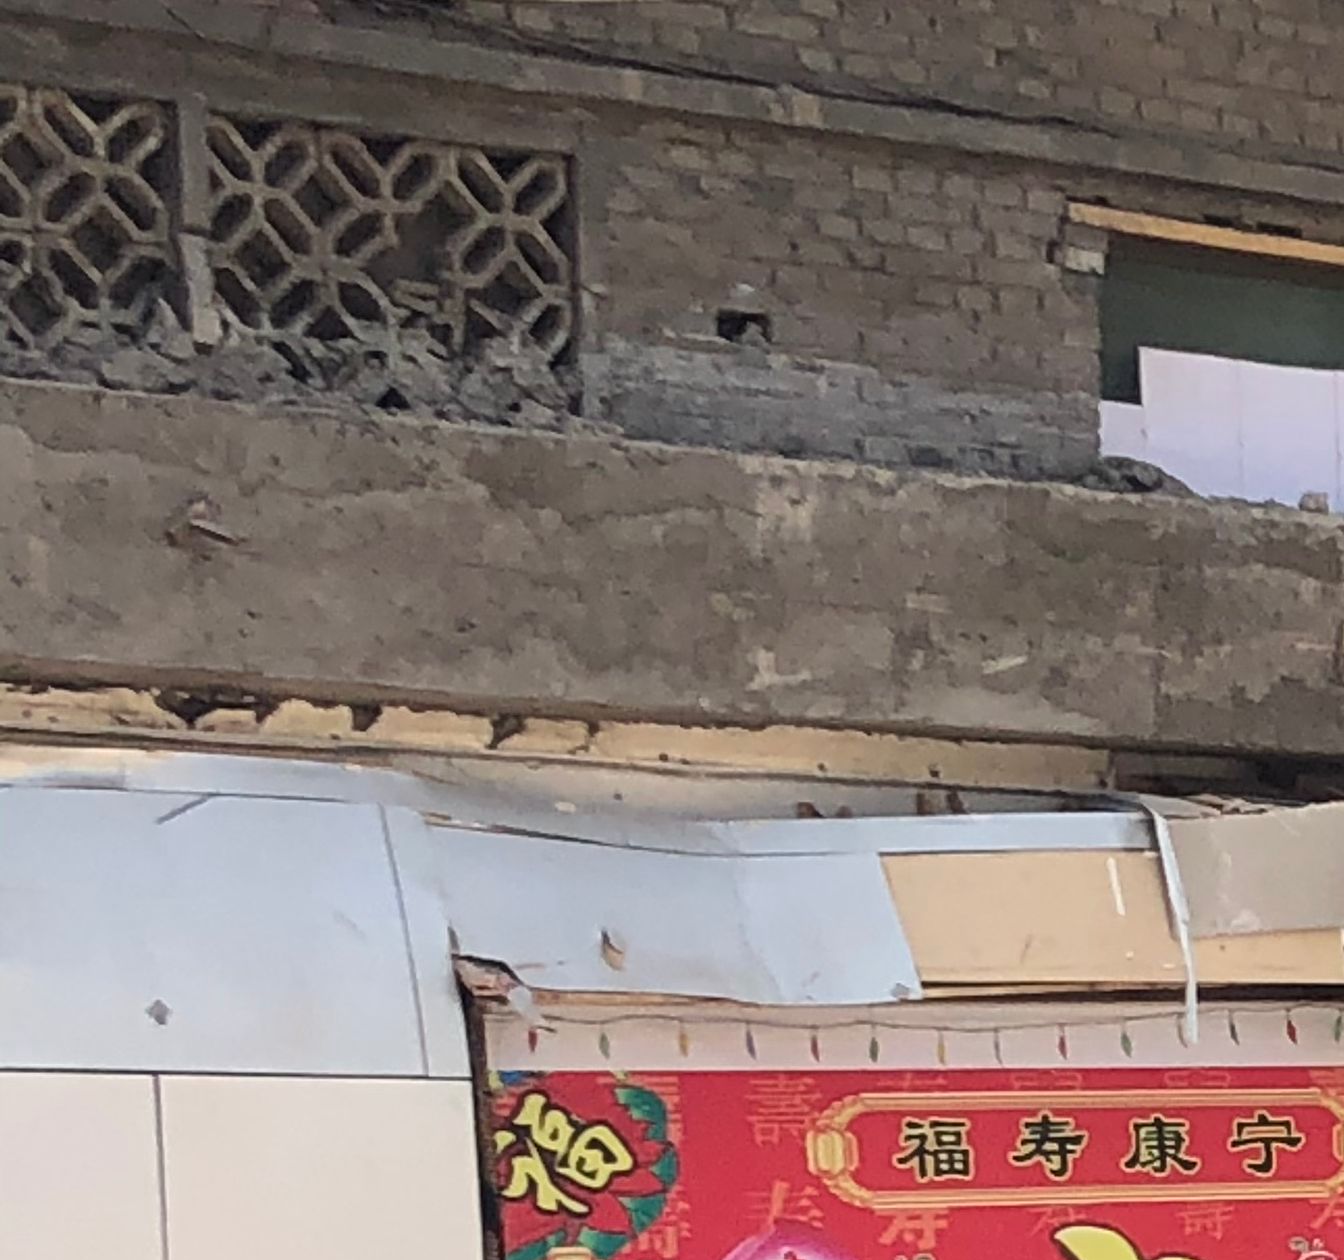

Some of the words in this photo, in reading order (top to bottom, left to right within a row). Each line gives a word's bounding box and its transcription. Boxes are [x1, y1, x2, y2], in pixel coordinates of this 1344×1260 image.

[494, 1093, 635, 1216] 福
[895, 1111, 1304, 1181] 福寿康宁
